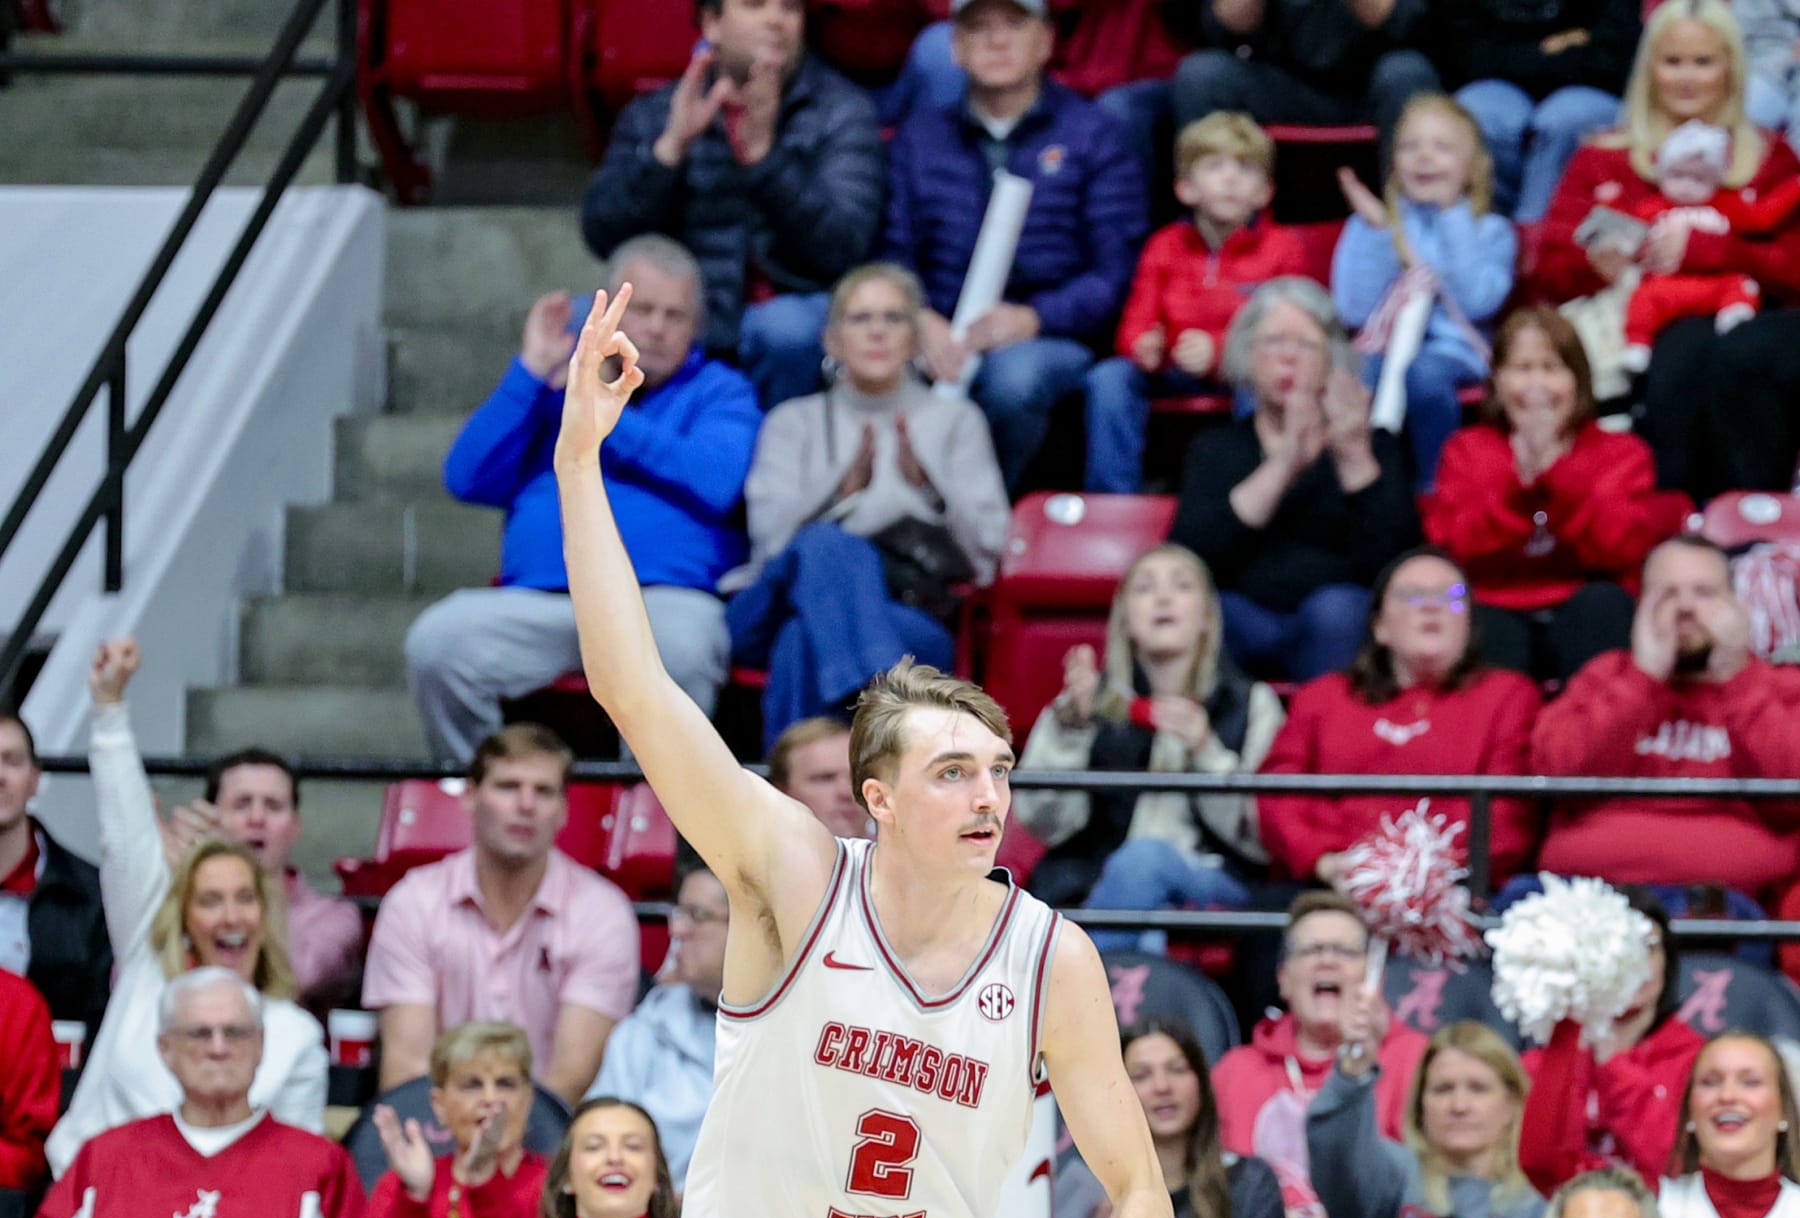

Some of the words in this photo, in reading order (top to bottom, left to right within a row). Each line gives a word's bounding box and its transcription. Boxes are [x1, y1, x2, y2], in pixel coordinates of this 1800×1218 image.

[979, 983, 1014, 1020] SEC
[814, 1021, 989, 1108] CRIMSON
[845, 1108, 921, 1200] 2
